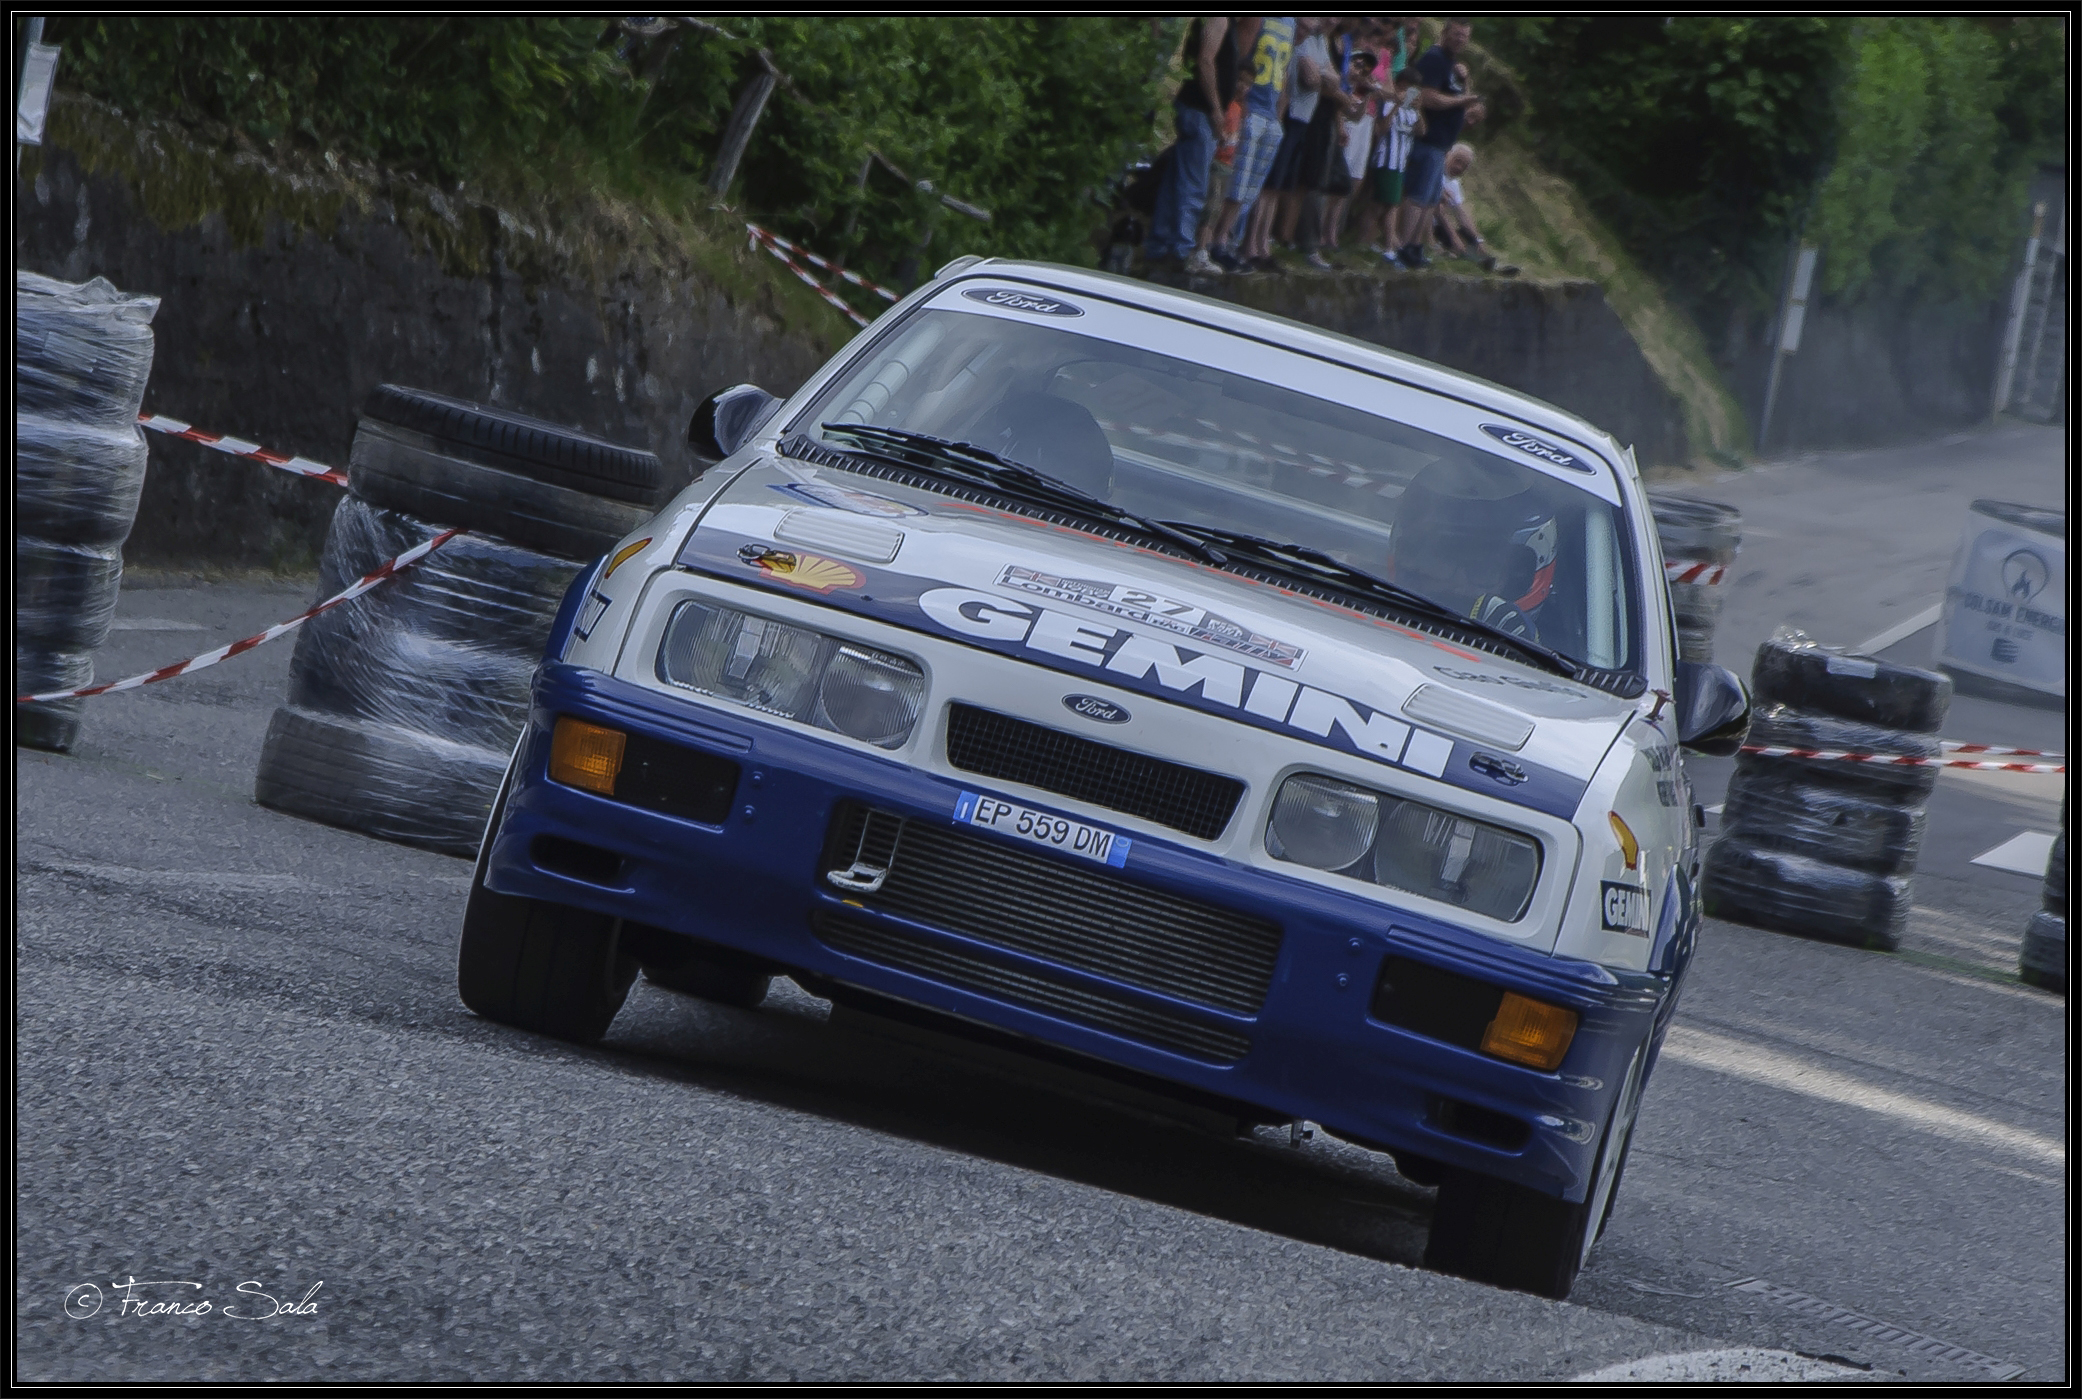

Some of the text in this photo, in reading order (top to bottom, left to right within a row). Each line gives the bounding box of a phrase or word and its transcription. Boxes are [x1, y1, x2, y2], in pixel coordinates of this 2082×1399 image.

[985, 291, 1061, 313] Ford
[1502, 432, 1574, 466] Ford
[1001, 576, 1150, 621] Lombard
[1119, 590, 1196, 617] 27
[919, 588, 1456, 778] GEMINI
[1075, 698, 1119, 719] Ford
[975, 798, 1013, 826] EP
[1015, 810, 1070, 845] 559
[1073, 826, 1112, 858] DM
